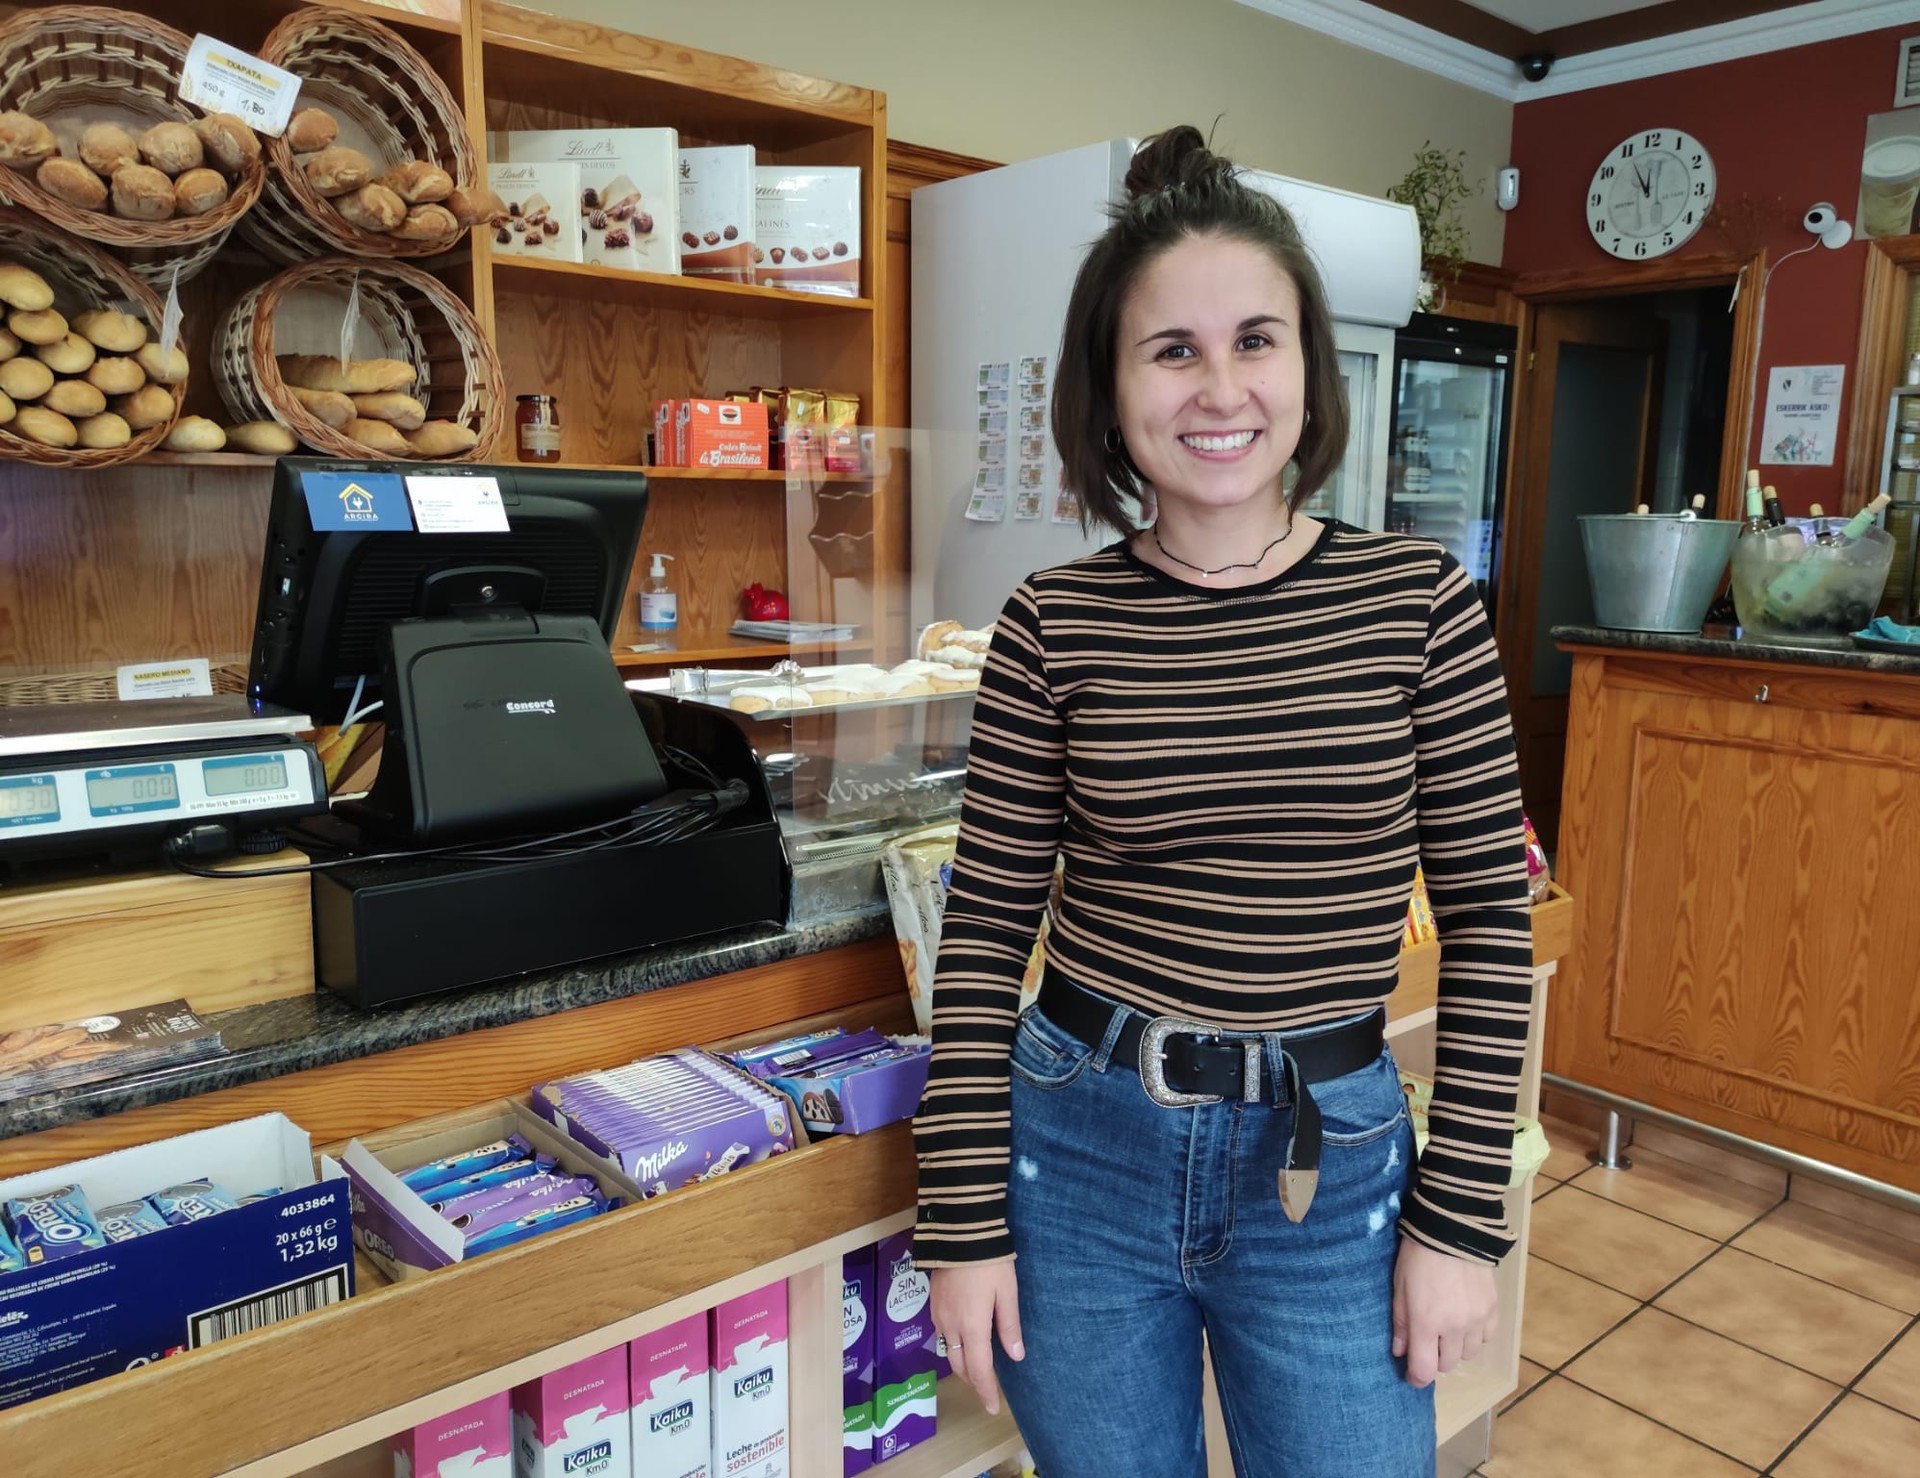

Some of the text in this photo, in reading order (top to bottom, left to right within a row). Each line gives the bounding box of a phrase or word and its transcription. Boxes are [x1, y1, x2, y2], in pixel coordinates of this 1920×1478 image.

[226, 59, 262, 80] TXAPATA
[202, 82, 218, 93] 450
[565, 140, 604, 155] Lindt
[1644, 132, 1661, 148] 12
[1675, 137, 1682, 150] 1
[1621, 144, 1633, 158] 11
[1692, 155, 1701, 169] 2
[498, 168, 527, 179] Lindt
[1600, 166, 1614, 180] 10
[1694, 182, 1705, 196] 3
[1591, 193, 1601, 207] 9
[1596, 219, 1605, 233] 8
[1682, 211, 1692, 224] 4
[1613, 238, 1621, 252] 7
[1662, 232, 1673, 246] 5
[1635, 242, 1646, 256] 6
[1776, 404, 1807, 412] ESKERRIK
[709, 450, 762, 467] Brasileña
[344, 513, 378, 521] ARGIRA
[506, 699, 556, 712] Concord
[32, 777, 43, 785] kg
[635, 1141, 689, 1182] Milka
[281, 1193, 335, 1217] 4033864
[28, 1200, 82, 1241] OREO
[276, 1232, 289, 1246] 20
[291, 1232, 298, 1241] x
[299, 1225, 313, 1238] 66
[315, 1224, 322, 1236] g
[280, 1235, 338, 1262] 1,32 kg
[364, 1228, 396, 1261] OREO
[898, 1275, 917, 1293] SIN
[889, 1285, 927, 1309] LACTOSA
[734, 1310, 768, 1329] DESNATADA
[894, 1332, 923, 1350] SOSTENIBLE
[650, 1342, 688, 1362] DESNATADA
[563, 1379, 605, 1400] DESNATADA
[736, 1371, 770, 1397] Kaiku
[886, 1382, 930, 1407] SEMIDESNATADA
[652, 1404, 690, 1430] Kaiku
[438, 1420, 485, 1442] DESNATADA
[566, 1445, 608, 1472] Kaiku
[726, 1442, 753, 1461] Leche
[726, 1434, 785, 1473] sostenible
